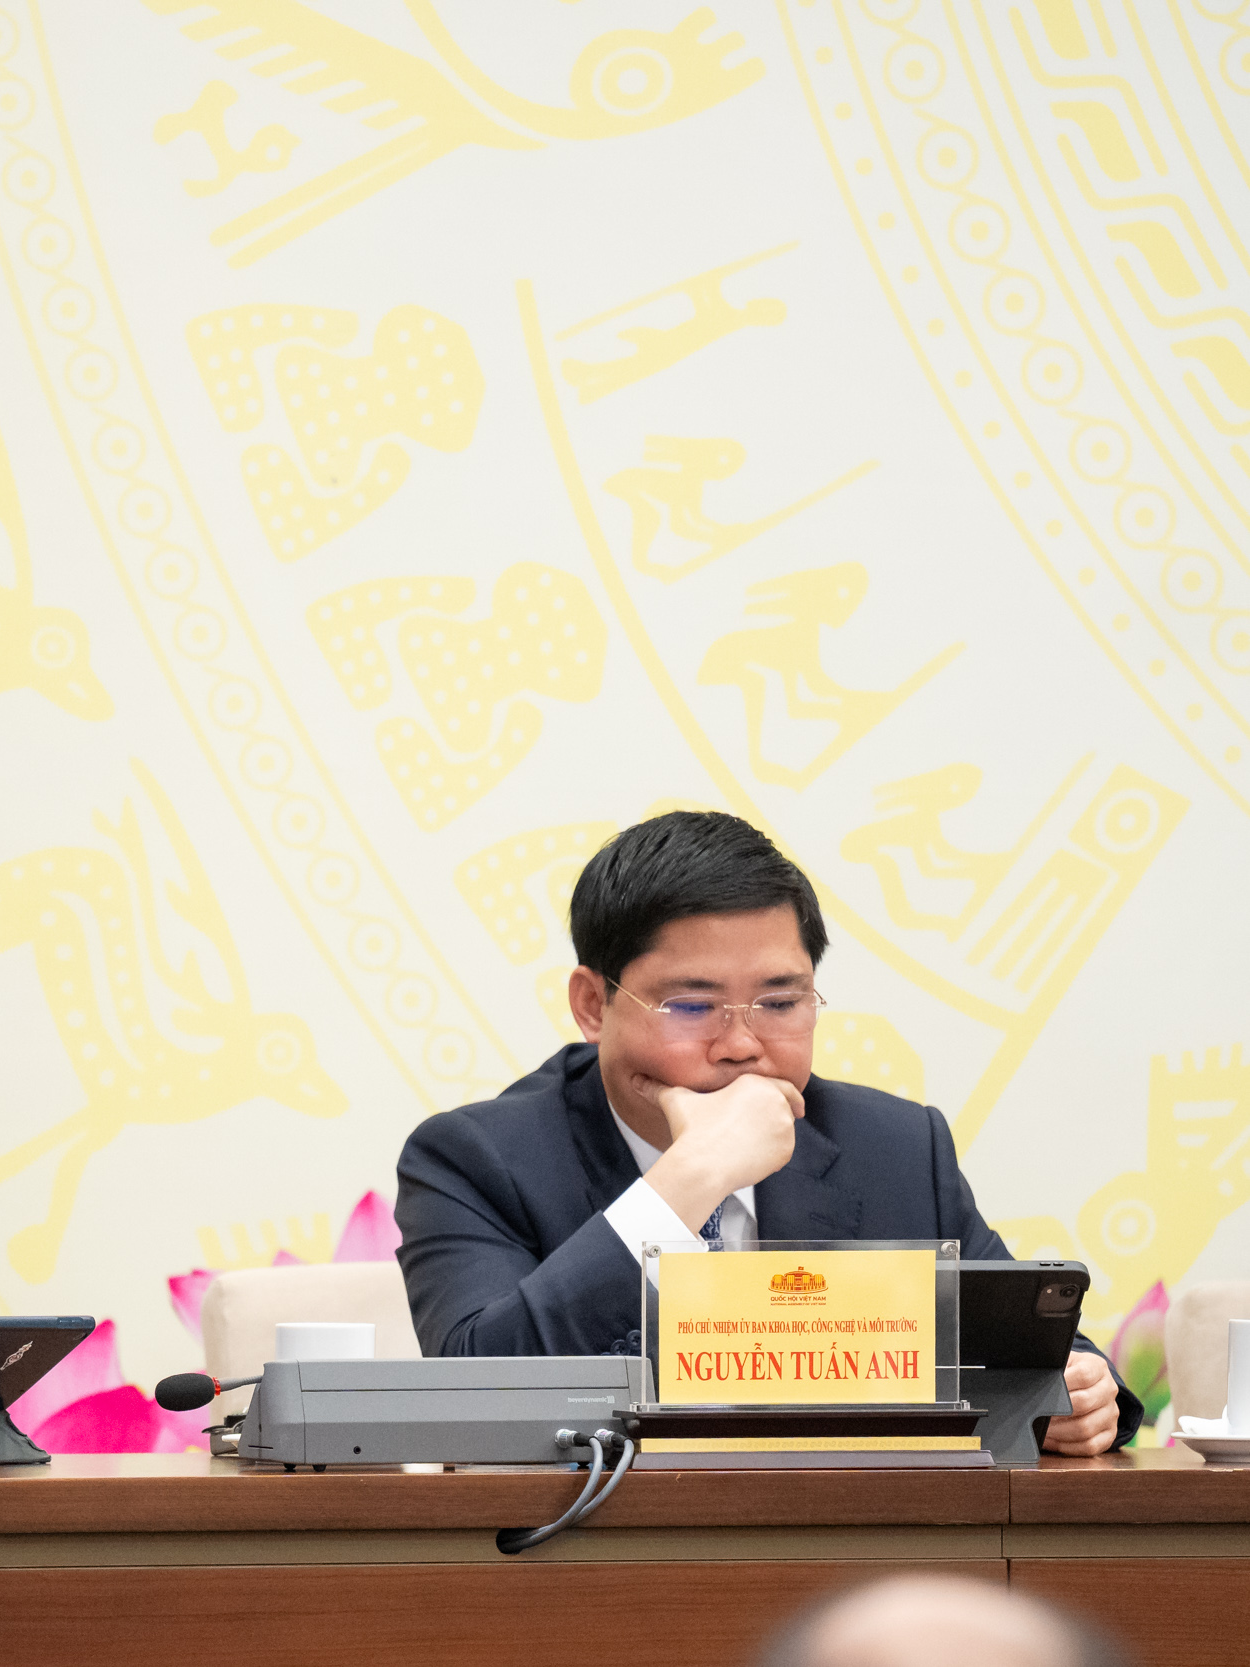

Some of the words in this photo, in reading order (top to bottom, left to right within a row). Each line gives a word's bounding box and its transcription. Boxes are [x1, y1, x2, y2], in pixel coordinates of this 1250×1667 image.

[770, 1294, 786, 1302] QUỐC
[677, 1318, 694, 1334] PHÓ
[695, 1317, 712, 1334] CHỦ
[713, 1319, 739, 1336] NHIỆM
[739, 1317, 751, 1334] ỦY
[751, 1321, 768, 1334] BAN
[768, 1320, 791, 1334] KHOA
[791, 1320, 810, 1336] HỌC,
[811, 1317, 833, 1333] CÔNG
[834, 1318, 856, 1336] NGHỆ
[856, 1316, 868, 1333] VÀ
[868, 1316, 885, 1333] MÔI
[885, 1316, 918, 1333] TRƯỜNG
[676, 1342, 784, 1381] NGUYỄN
[790, 1341, 860, 1380] TUẤN
[865, 1350, 920, 1379] ANH
